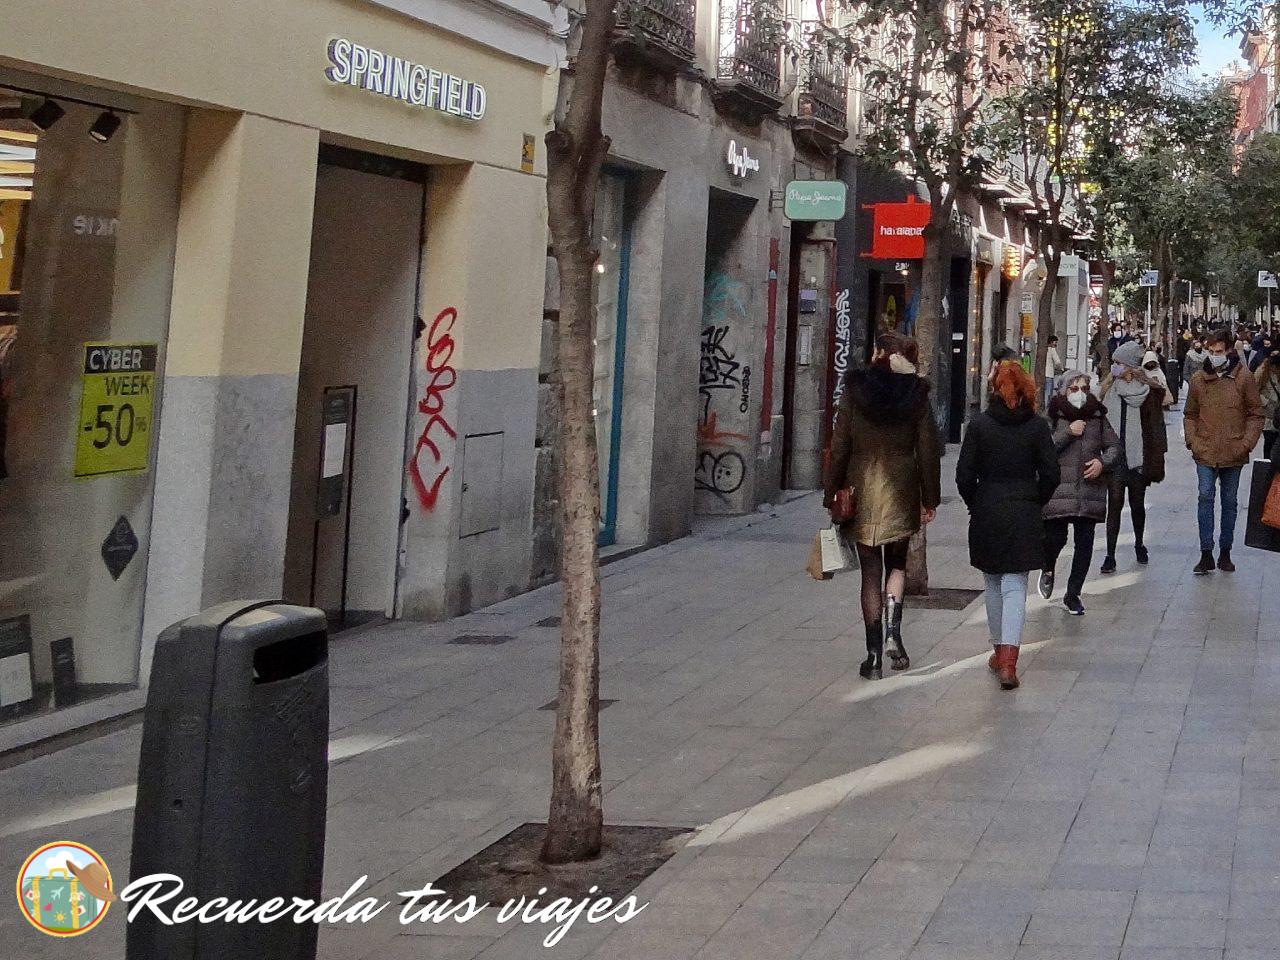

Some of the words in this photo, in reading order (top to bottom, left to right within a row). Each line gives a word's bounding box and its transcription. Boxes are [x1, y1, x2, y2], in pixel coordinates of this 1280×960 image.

[326, 38, 487, 121] SPRINGFIELD
[89, 349, 143, 371] CYBER
[105, 374, 151, 397] WEEK
